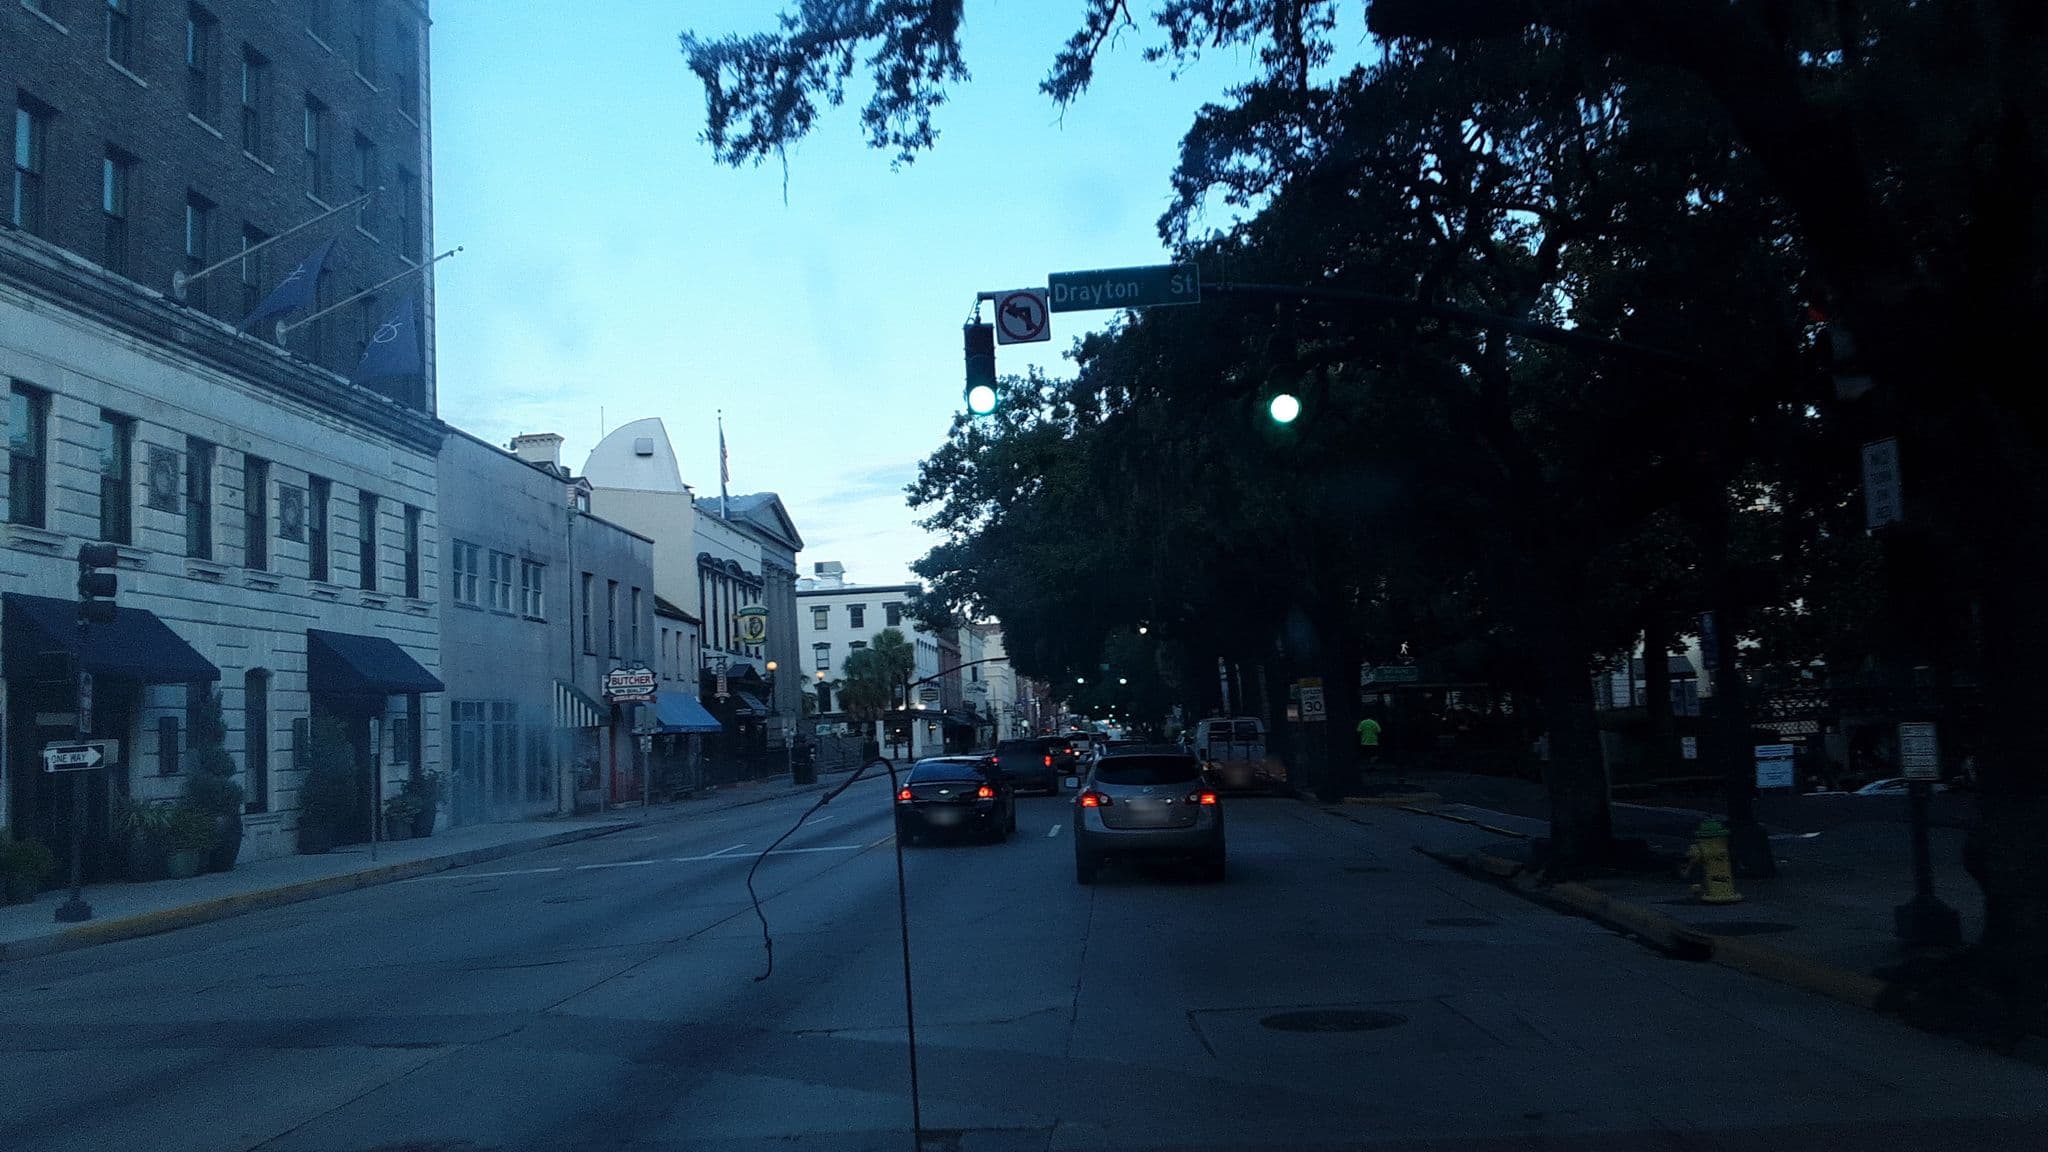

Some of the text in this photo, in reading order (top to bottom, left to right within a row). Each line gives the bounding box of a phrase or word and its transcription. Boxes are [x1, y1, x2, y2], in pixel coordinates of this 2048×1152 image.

[1054, 273, 1194, 304] Drayton St
[611, 675, 651, 686] BUTCHER
[1304, 701, 1322, 712] 30
[51, 752, 86, 763] ONE WAY
